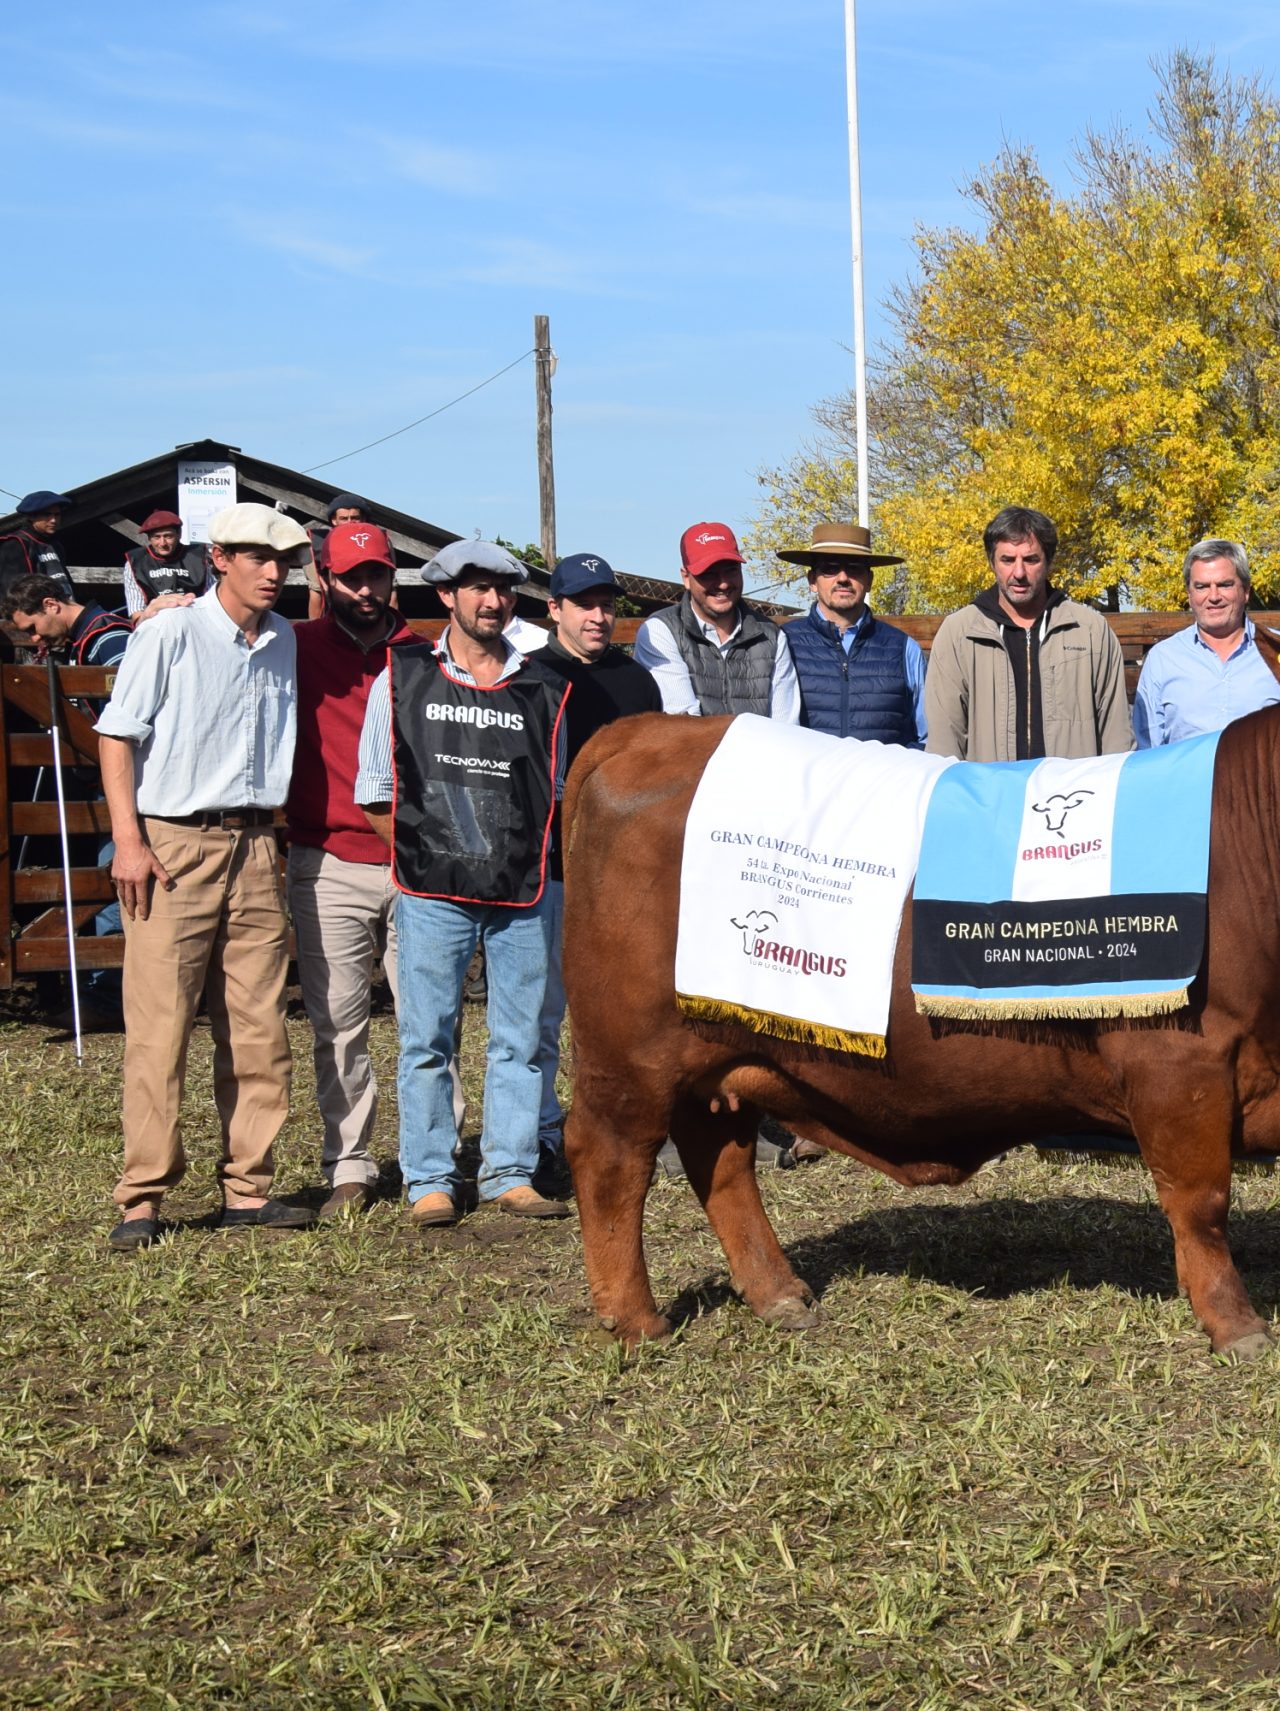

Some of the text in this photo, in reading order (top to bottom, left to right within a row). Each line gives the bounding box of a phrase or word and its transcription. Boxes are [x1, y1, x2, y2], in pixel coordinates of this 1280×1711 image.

[184, 476, 231, 486] ASPERSIN
[426, 703, 524, 731] BRANGUS
[435, 754, 511, 771] TECNOVAX
[709, 830, 897, 879] GRAN CAMPEONA HEMBRA
[1022, 838, 1103, 861] BRANGUS
[740, 871, 853, 905] BRANGUS Corrientes
[800, 870, 852, 891] Nacional
[777, 894, 800, 908] 2024
[945, 915, 1179, 939] GRAN CAMPEONA HEMBRA
[753, 938, 847, 978] BRANGUS
[984, 943, 1138, 963] GRAN NACIONAL 2024
